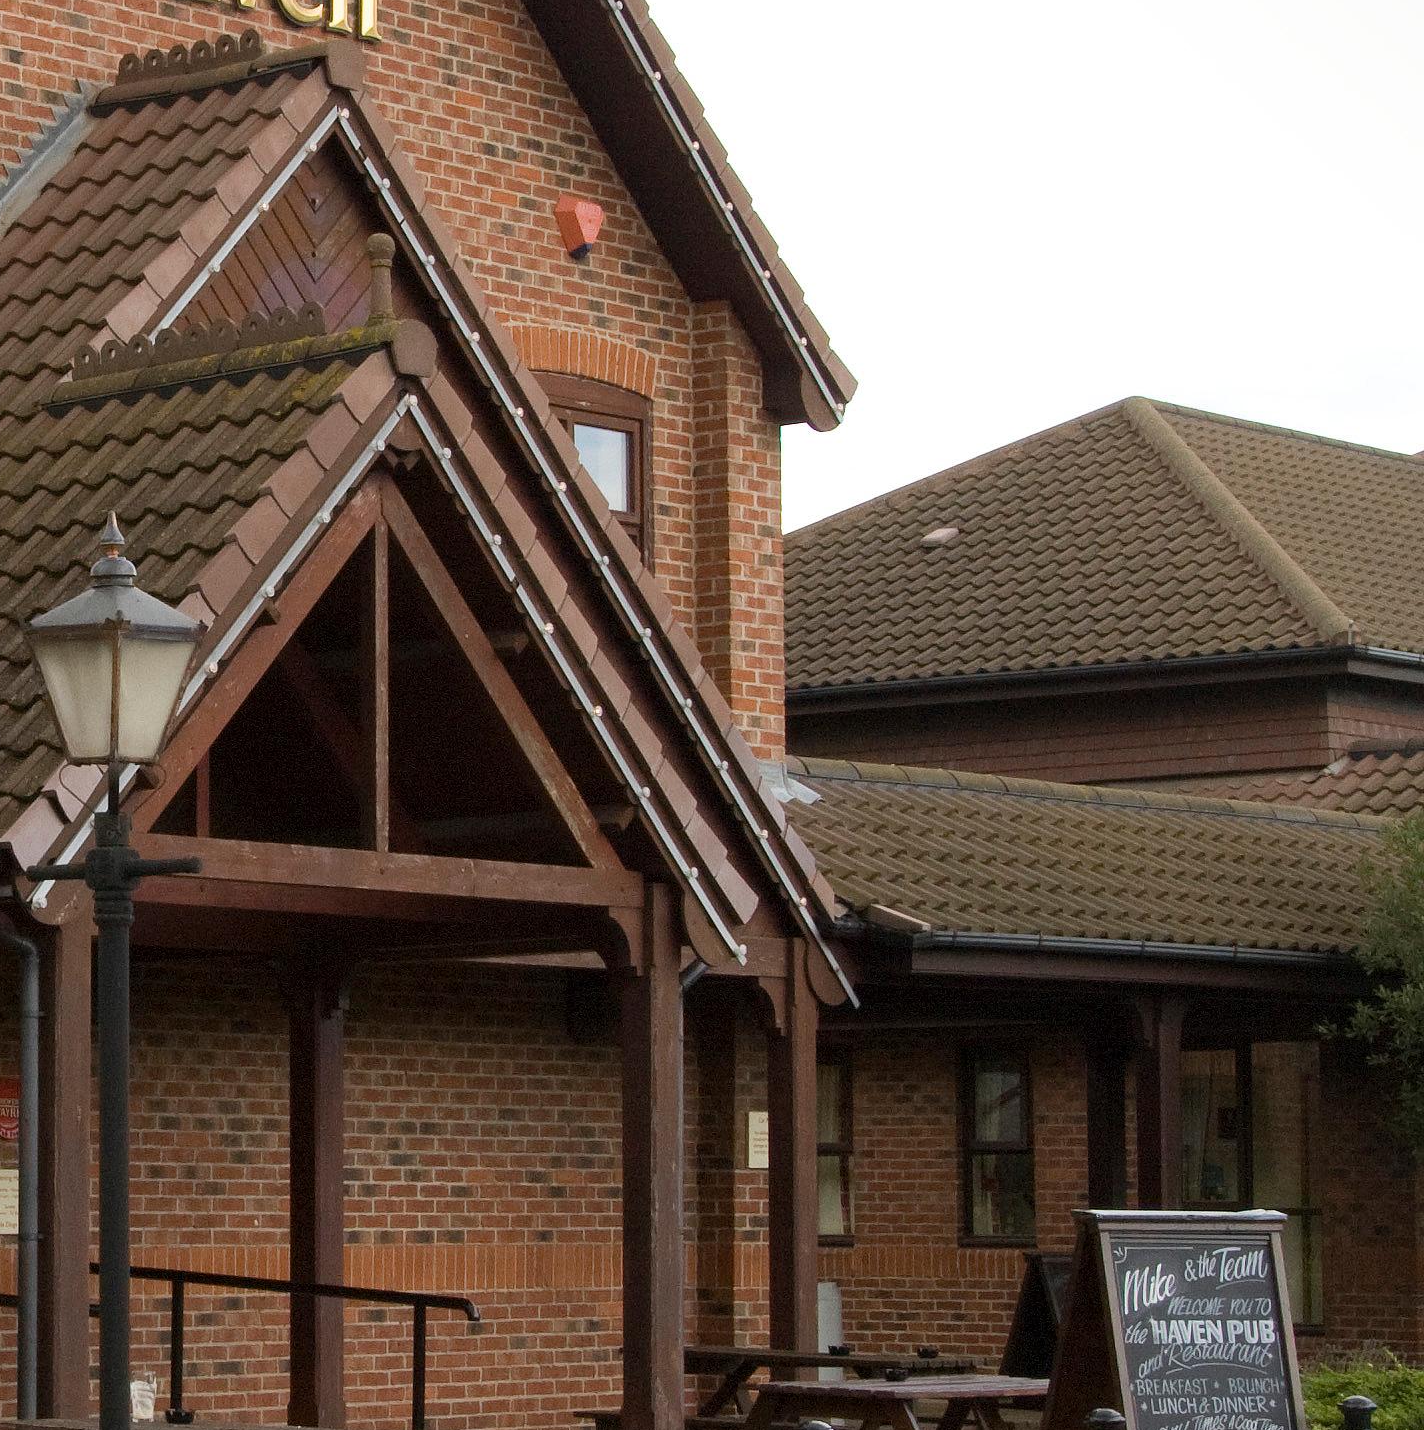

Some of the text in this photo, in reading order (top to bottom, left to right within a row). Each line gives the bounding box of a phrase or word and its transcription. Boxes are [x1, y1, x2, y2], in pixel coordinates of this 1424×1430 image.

[1124, 1247, 1268, 1315] Mike & the Team
[1168, 1296, 1272, 1315] WELCOME YOU TO
[1125, 1320, 1275, 1344] the HAVEN PUB
[1139, 1342, 1273, 1378] and Restaurant
[1136, 1378, 1280, 1396] BREAKFAST BRUNCH
[1150, 1396, 1269, 1415] LUNCH & DINNER
